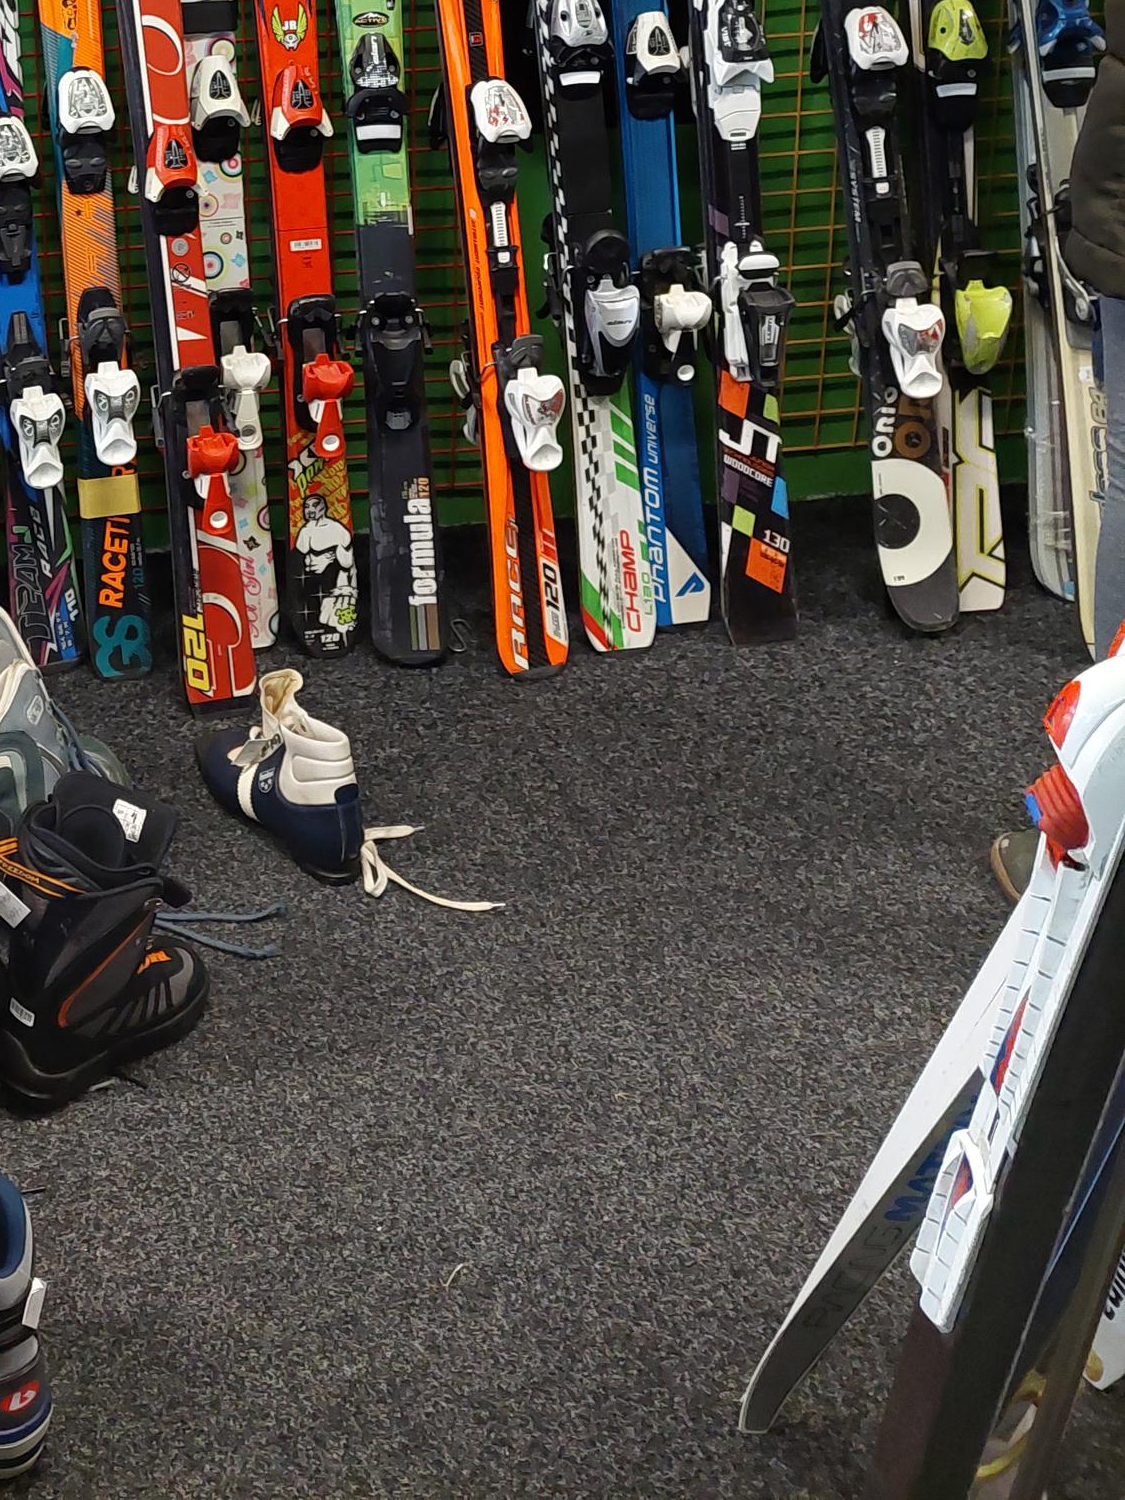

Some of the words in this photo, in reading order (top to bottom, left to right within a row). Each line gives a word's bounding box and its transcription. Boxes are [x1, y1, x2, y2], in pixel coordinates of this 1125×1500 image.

[281, 19, 298, 31] JR
[724, 453, 774, 488] WOODCORE
[418, 477, 430, 498] 120
[403, 499, 438, 607] formula
[763, 528, 791, 554] 130
[541, 562, 560, 613] 120
[182, 613, 213, 693] 120
[320, 632, 341, 644] 120
